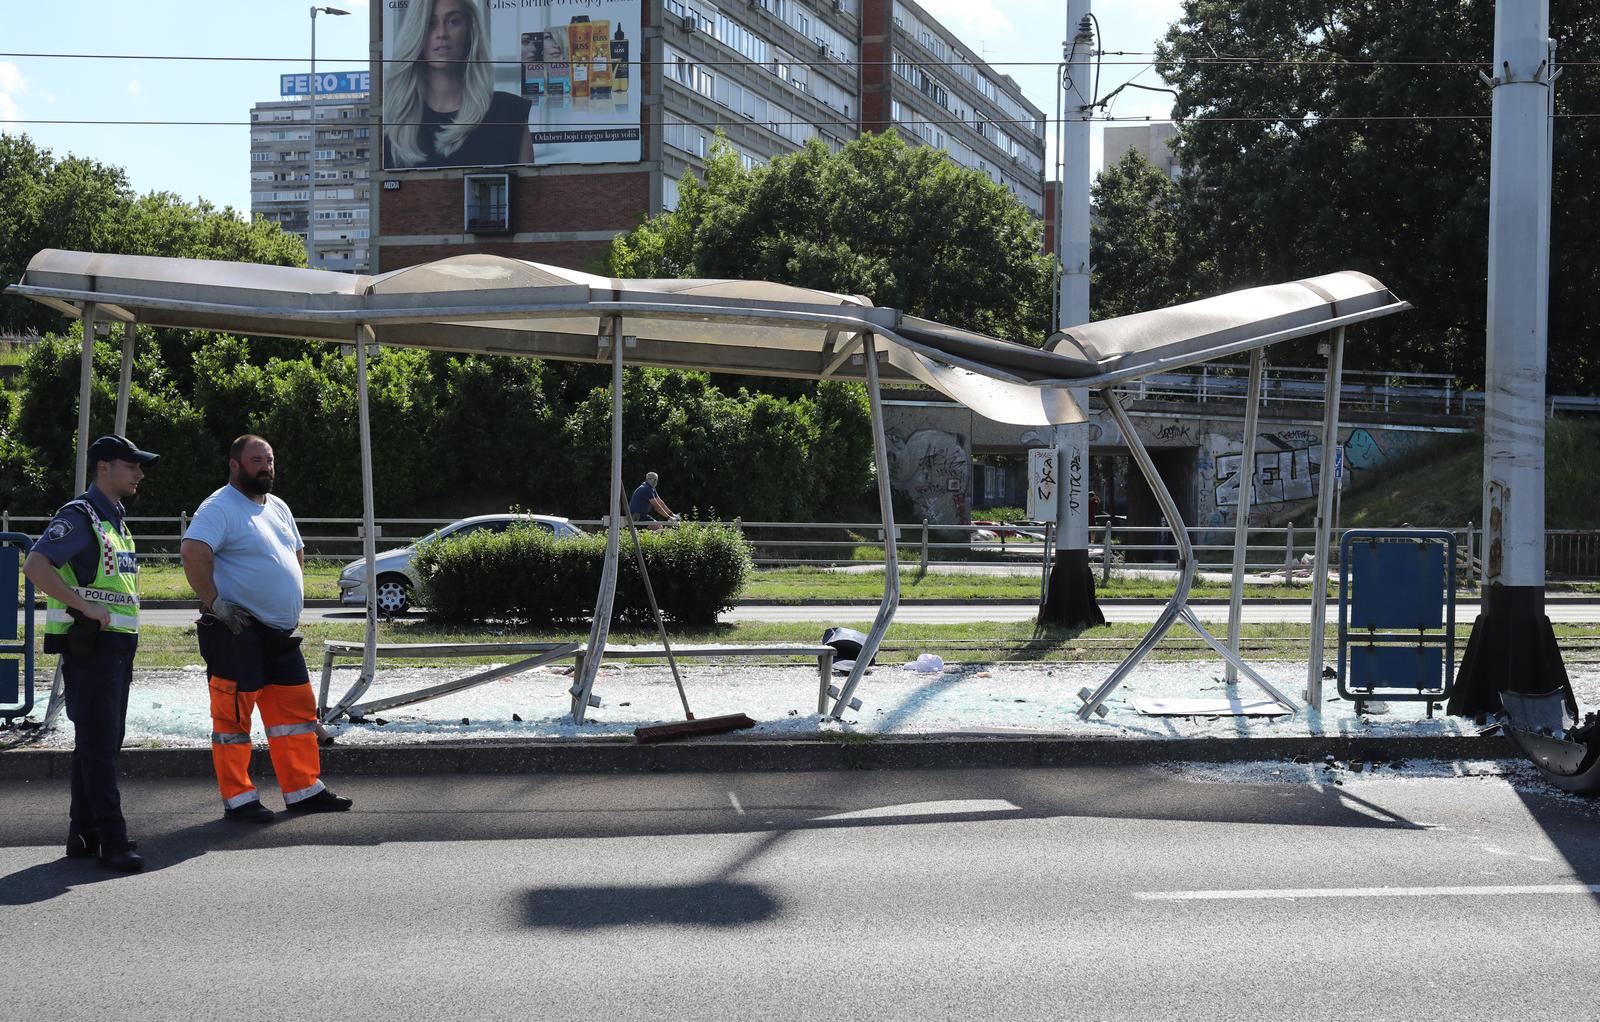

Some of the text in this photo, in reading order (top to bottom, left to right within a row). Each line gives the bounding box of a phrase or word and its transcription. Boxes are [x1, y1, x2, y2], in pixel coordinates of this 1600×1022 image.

[388, 1, 408, 9] GLISS
[282, 74, 338, 93] FERO
[534, 132, 562, 141] Odaberi
[564, 132, 578, 141] boju
[605, 130, 620, 141] koju
